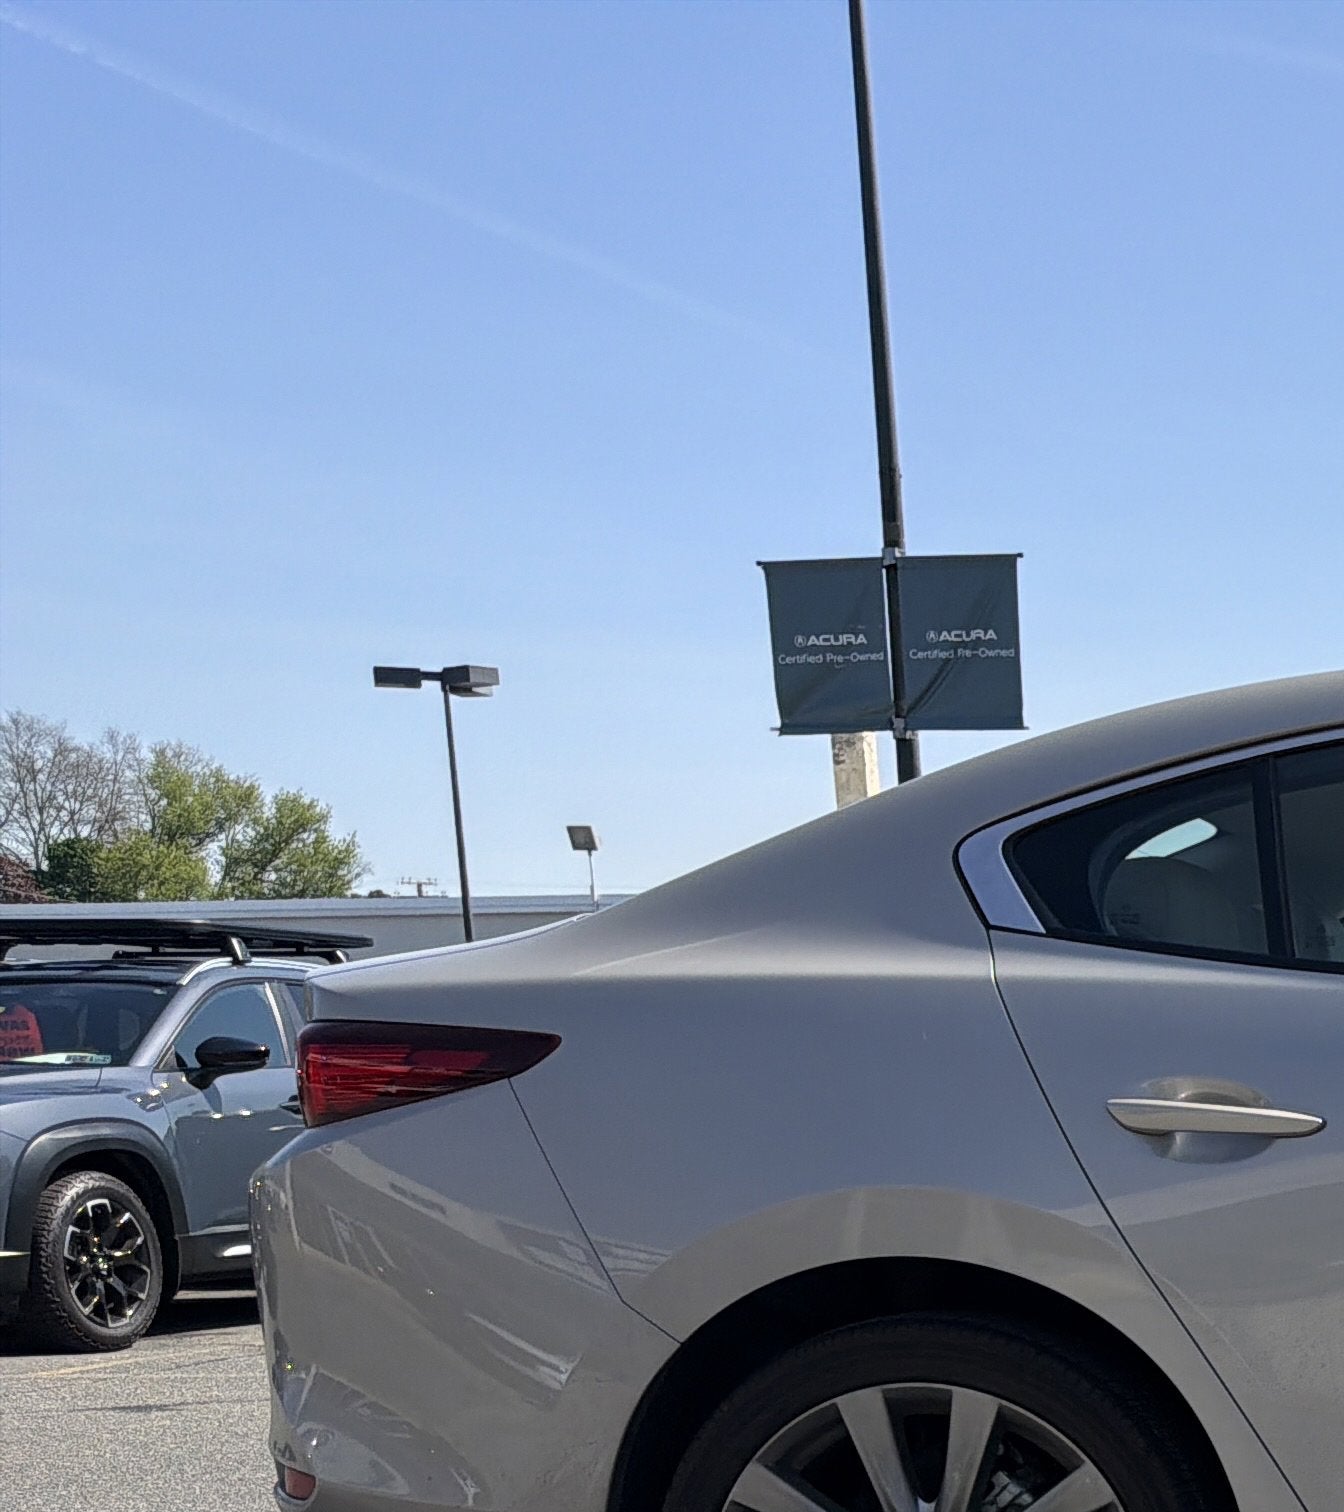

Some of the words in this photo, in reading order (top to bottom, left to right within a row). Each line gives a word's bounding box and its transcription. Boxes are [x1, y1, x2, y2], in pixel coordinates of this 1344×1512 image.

[807, 633, 868, 647] ACURA
[939, 629, 998, 642] ACURA
[778, 653, 824, 665] Certified
[826, 652, 885, 664] Pre-Owned
[909, 648, 955, 660] Certified
[957, 647, 1016, 659] Pre-Owned
